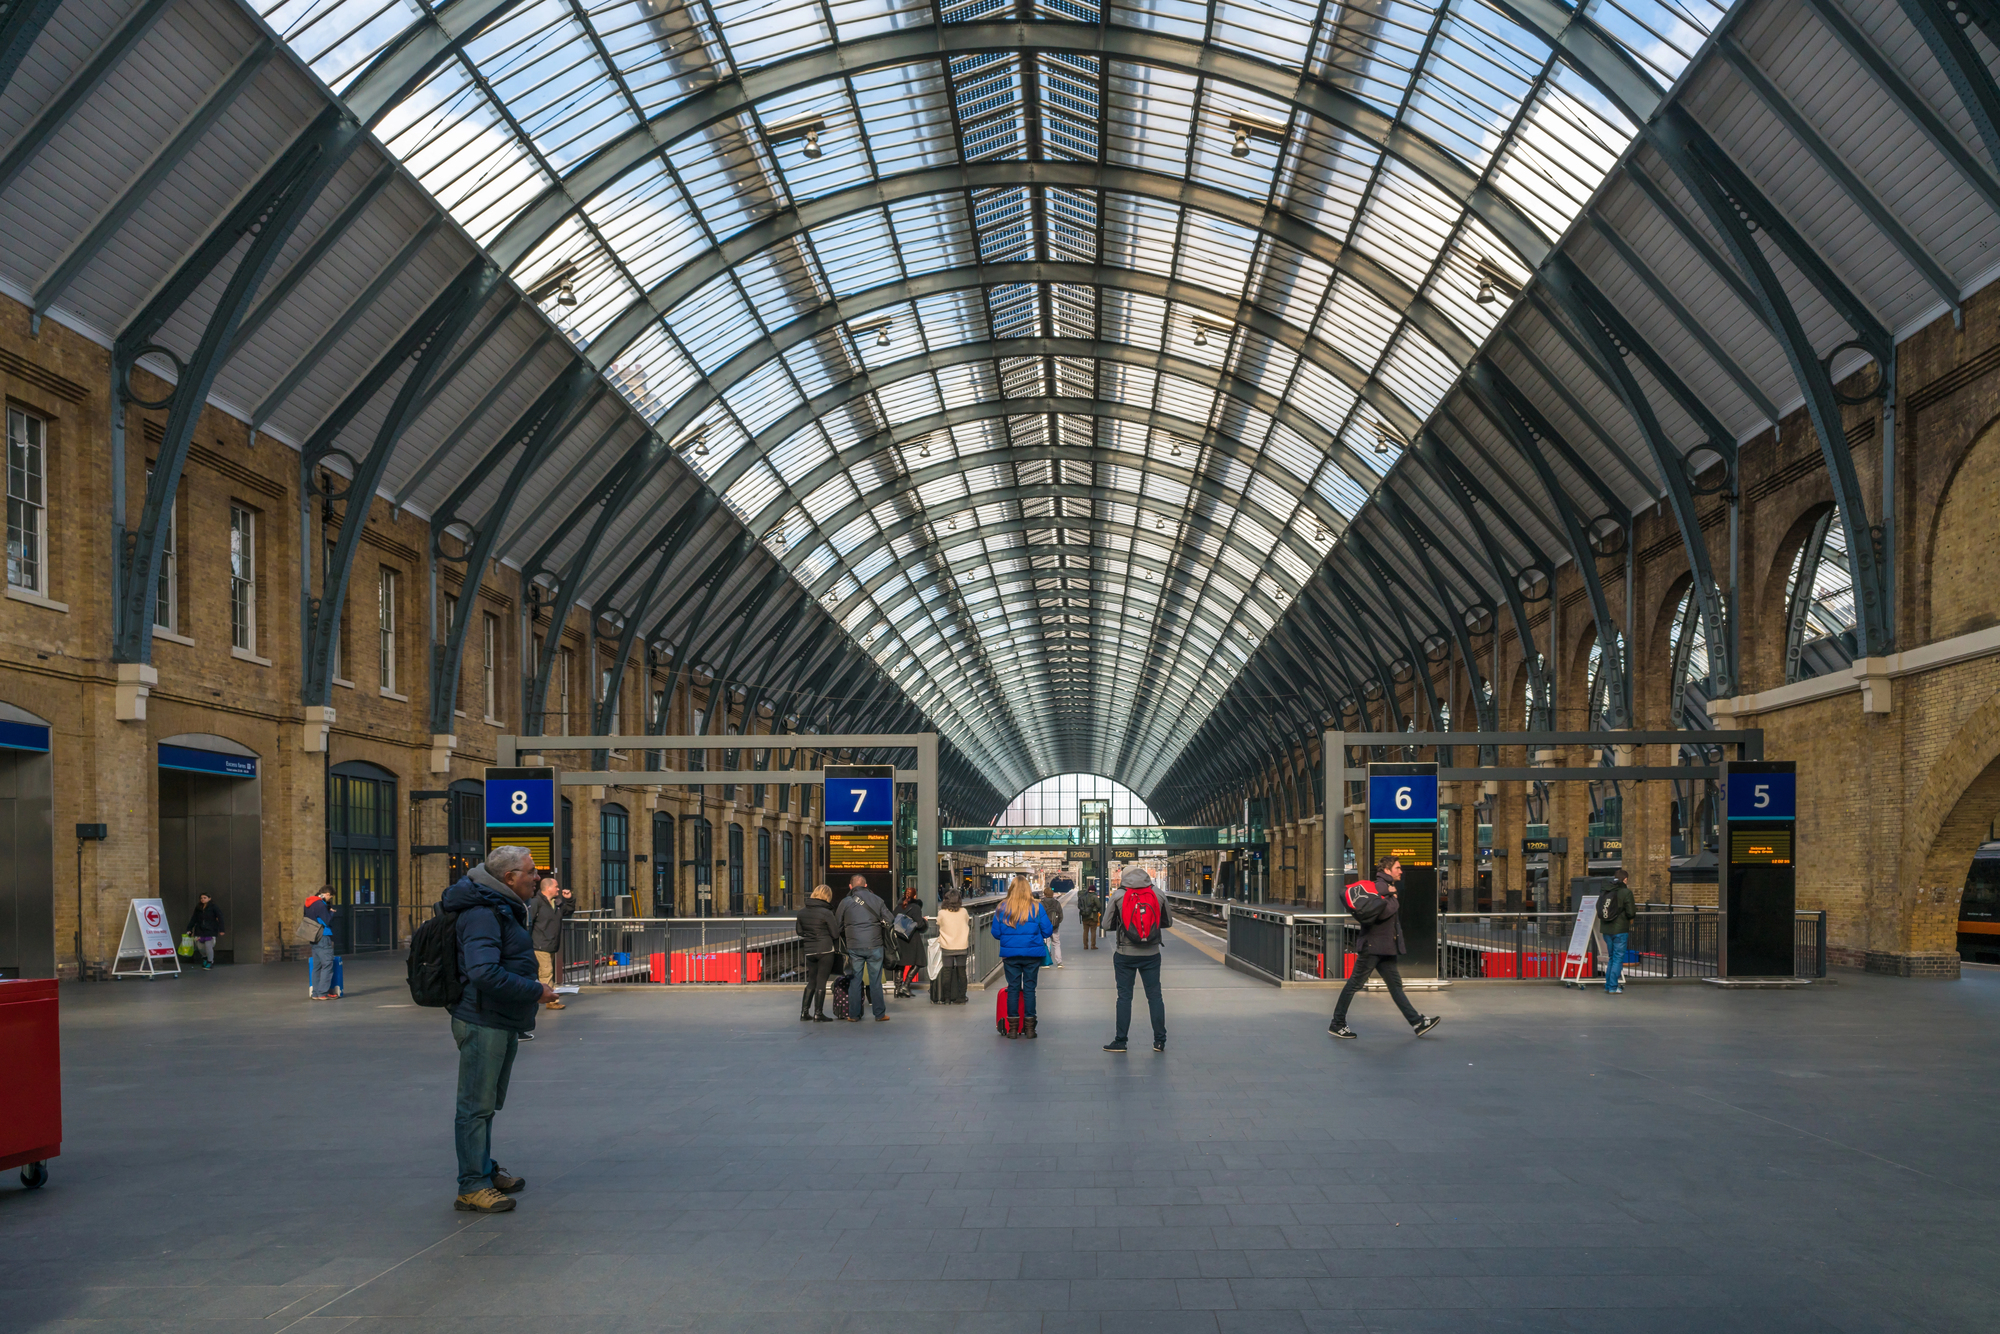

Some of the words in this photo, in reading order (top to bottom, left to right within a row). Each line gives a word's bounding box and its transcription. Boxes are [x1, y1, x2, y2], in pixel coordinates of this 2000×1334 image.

[511, 790, 528, 815] 8
[850, 790, 867, 812] 7
[1395, 786, 1412, 810] 6
[1720, 784, 1726, 801] 5
[1754, 784, 1770, 808] 5
[1602, 898, 1611, 919] adidas
